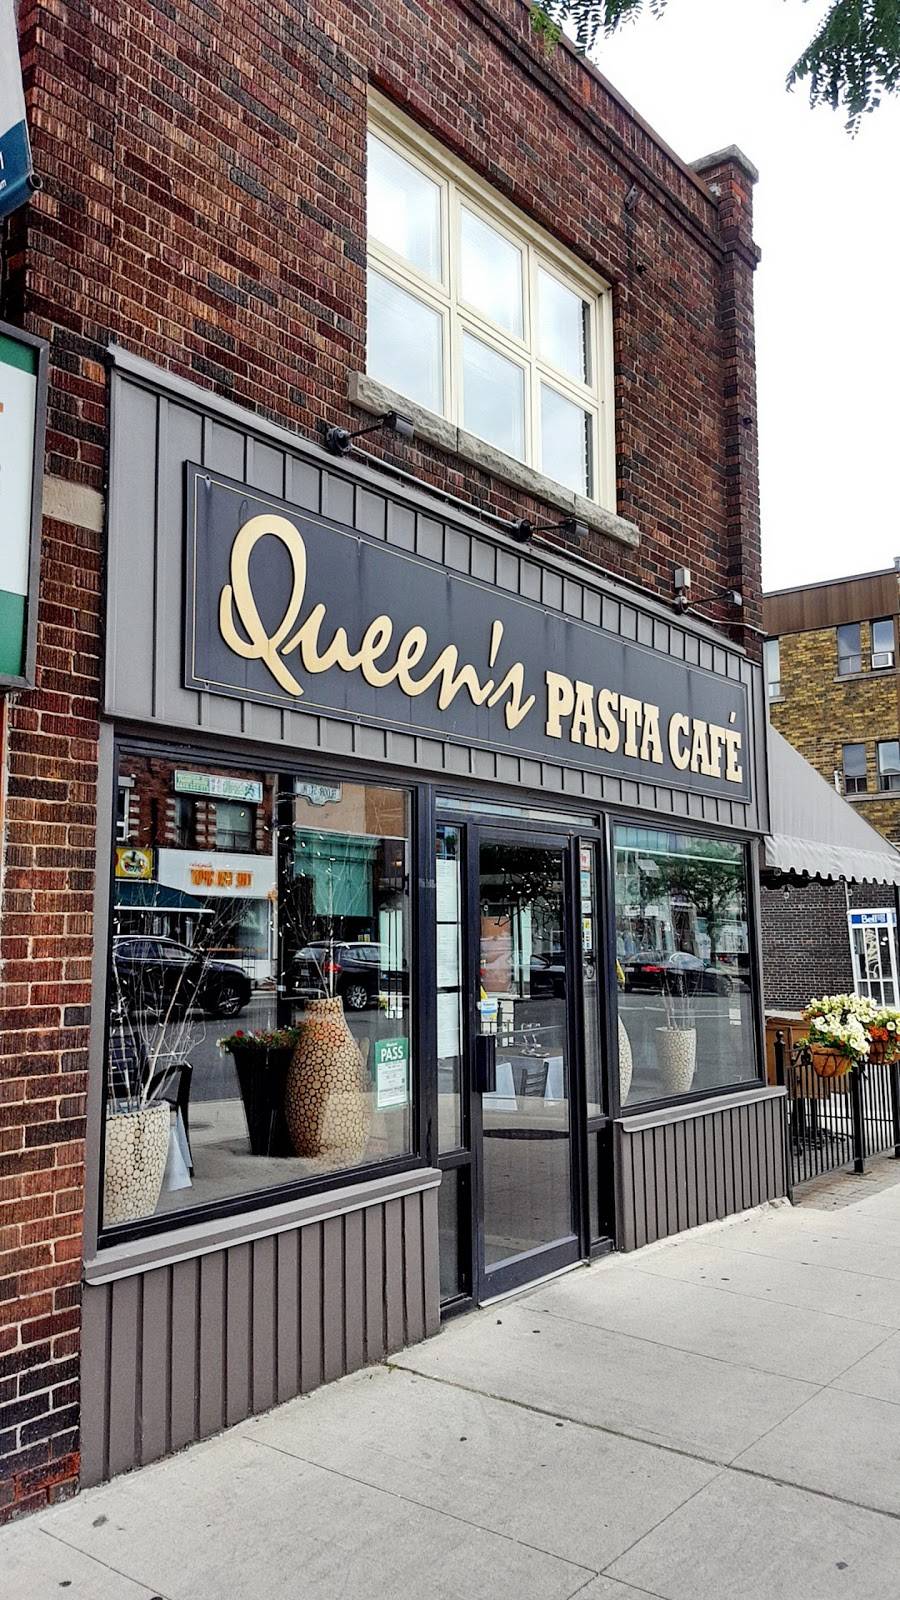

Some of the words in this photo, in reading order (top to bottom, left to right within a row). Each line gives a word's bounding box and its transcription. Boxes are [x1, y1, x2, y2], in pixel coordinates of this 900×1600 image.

[219, 514, 536, 730] Queen's
[545, 670, 664, 765] PASTA
[668, 710, 743, 784] CAFÉ
[861, 914, 877, 923] Bell
[381, 1046, 403, 1062] PASS
